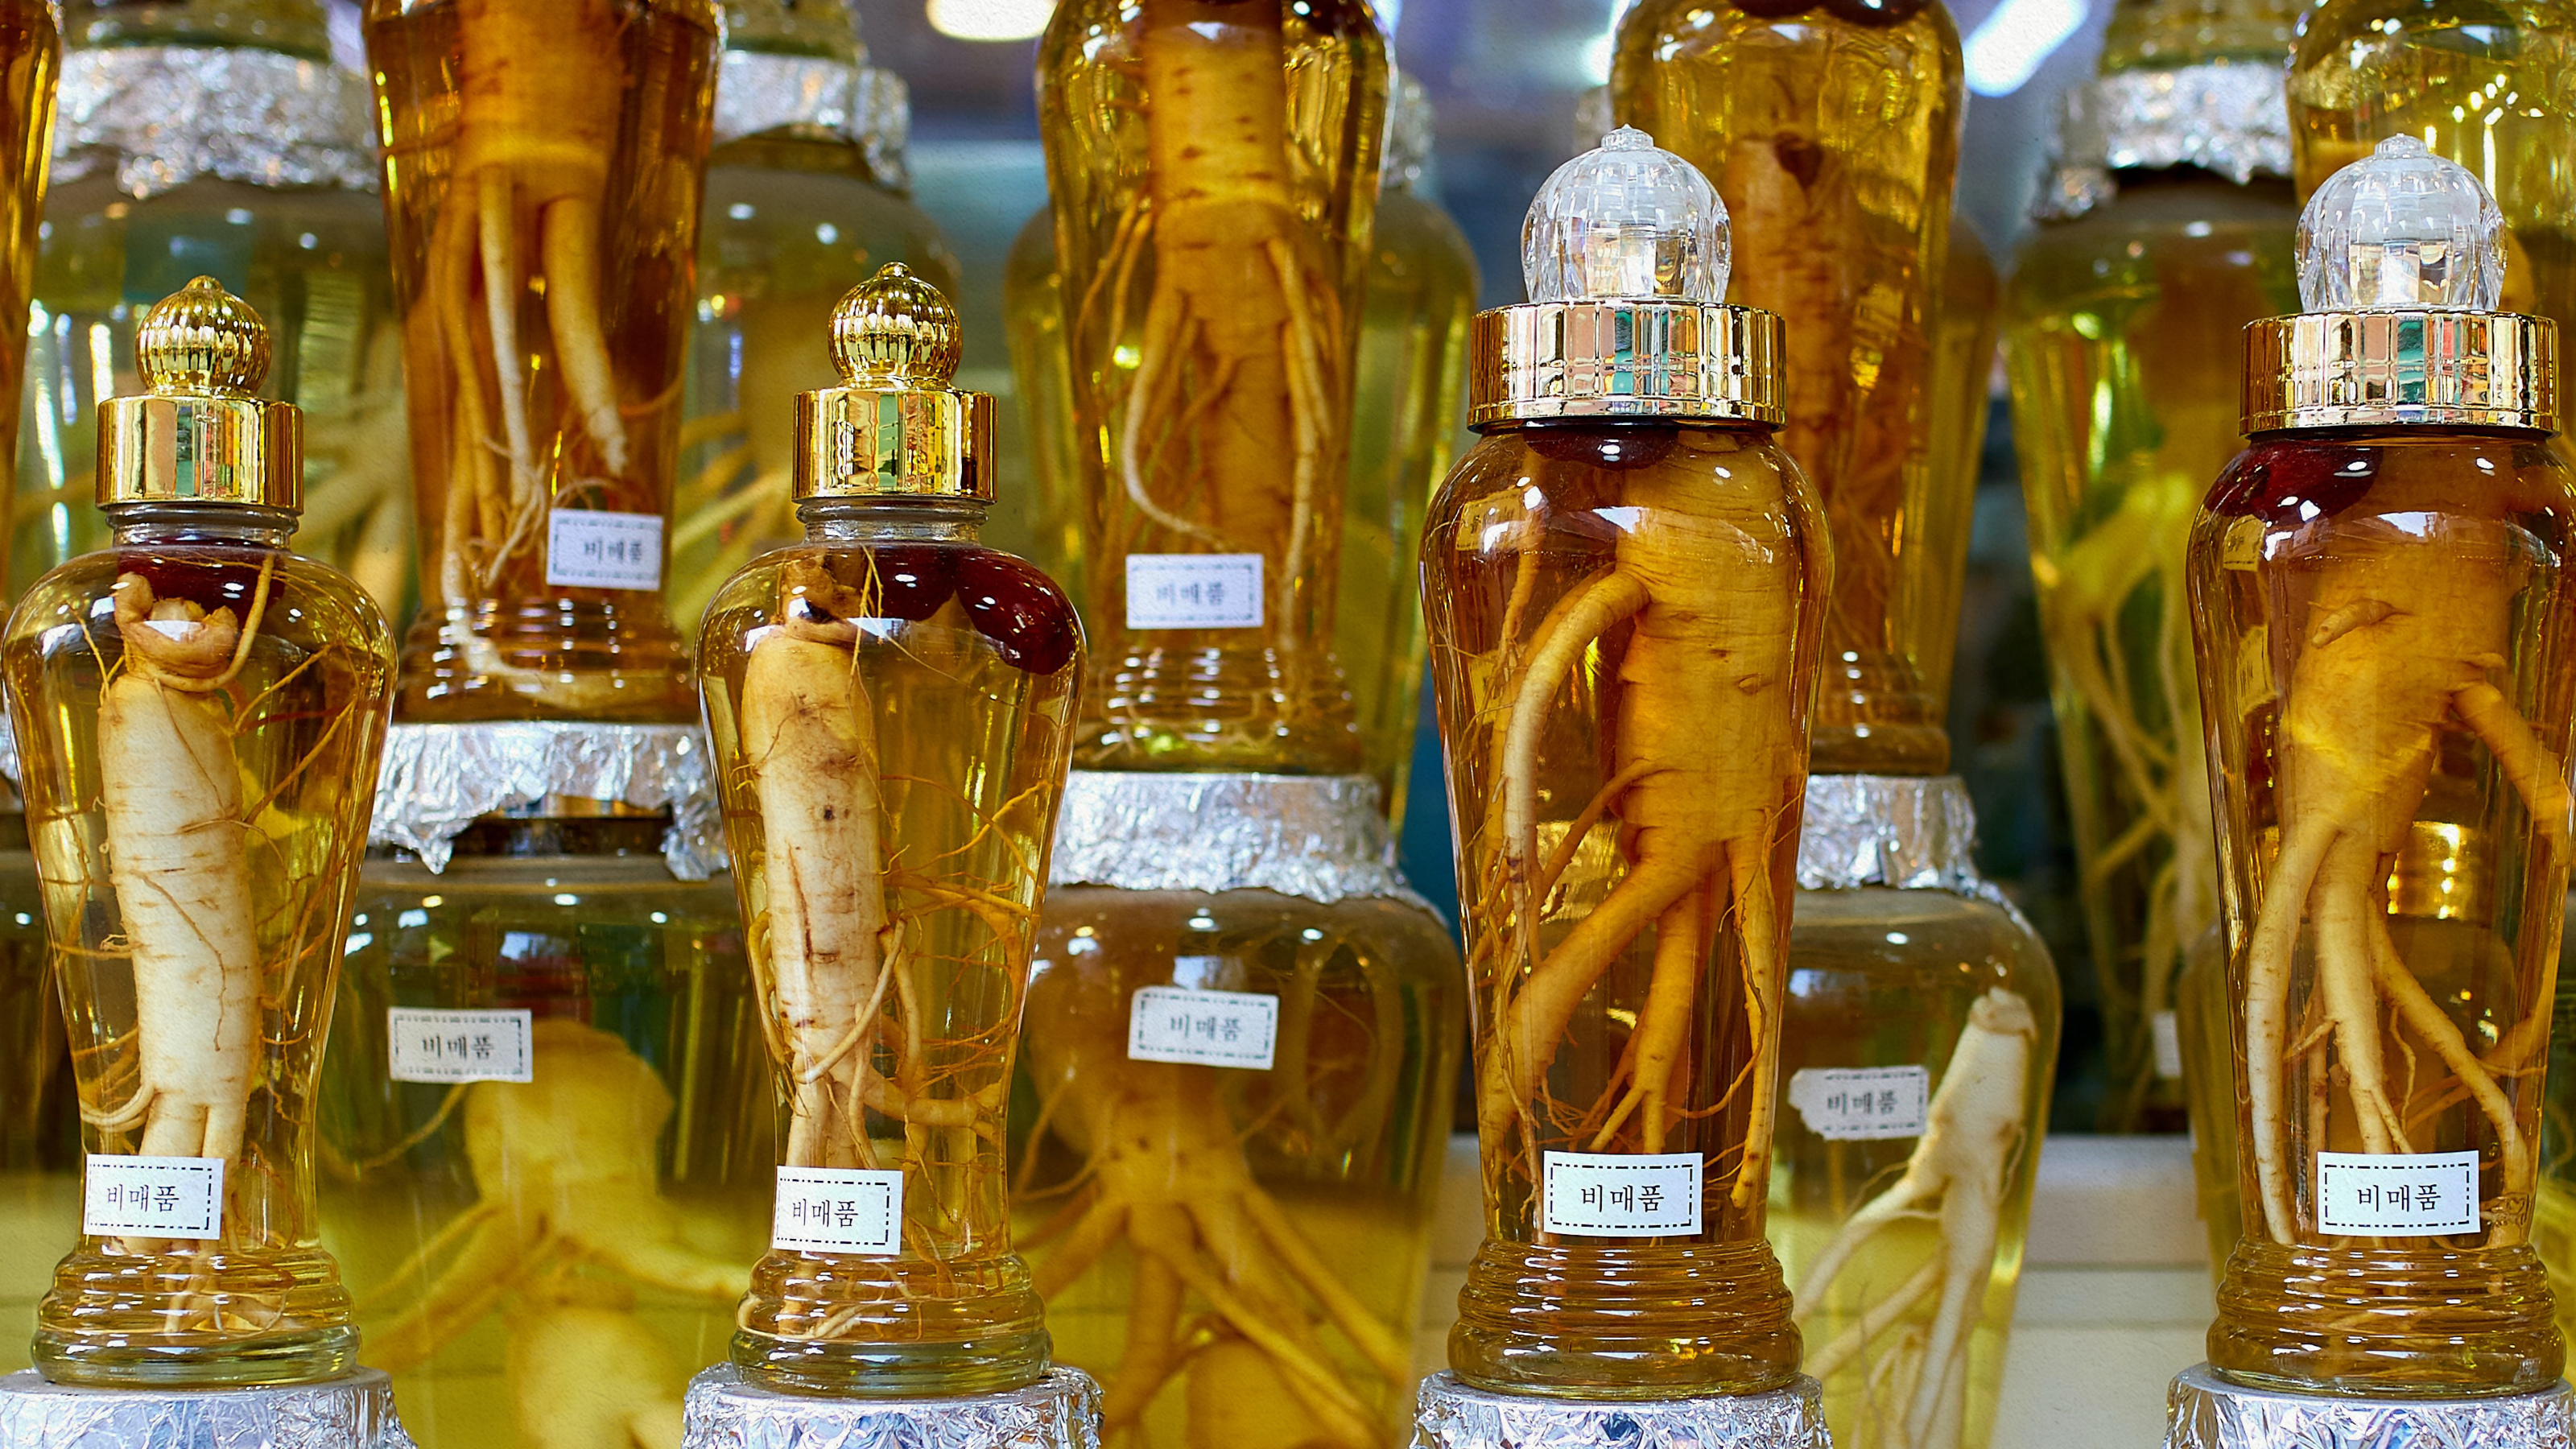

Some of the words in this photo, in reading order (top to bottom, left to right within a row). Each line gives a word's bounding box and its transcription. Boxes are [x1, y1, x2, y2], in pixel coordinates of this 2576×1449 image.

[582, 540, 644, 565] 비매품
[1155, 582, 1226, 605] 비매품
[1169, 1014, 1243, 1043] 비매품
[421, 1034, 496, 1060] 비매품
[1826, 1090, 1897, 1116] 비매품
[106, 1183, 180, 1212] 비매품
[1580, 1183, 1665, 1213] 비매품
[2356, 1183, 2442, 1212] 비매품
[791, 1197, 860, 1228] 비매품
